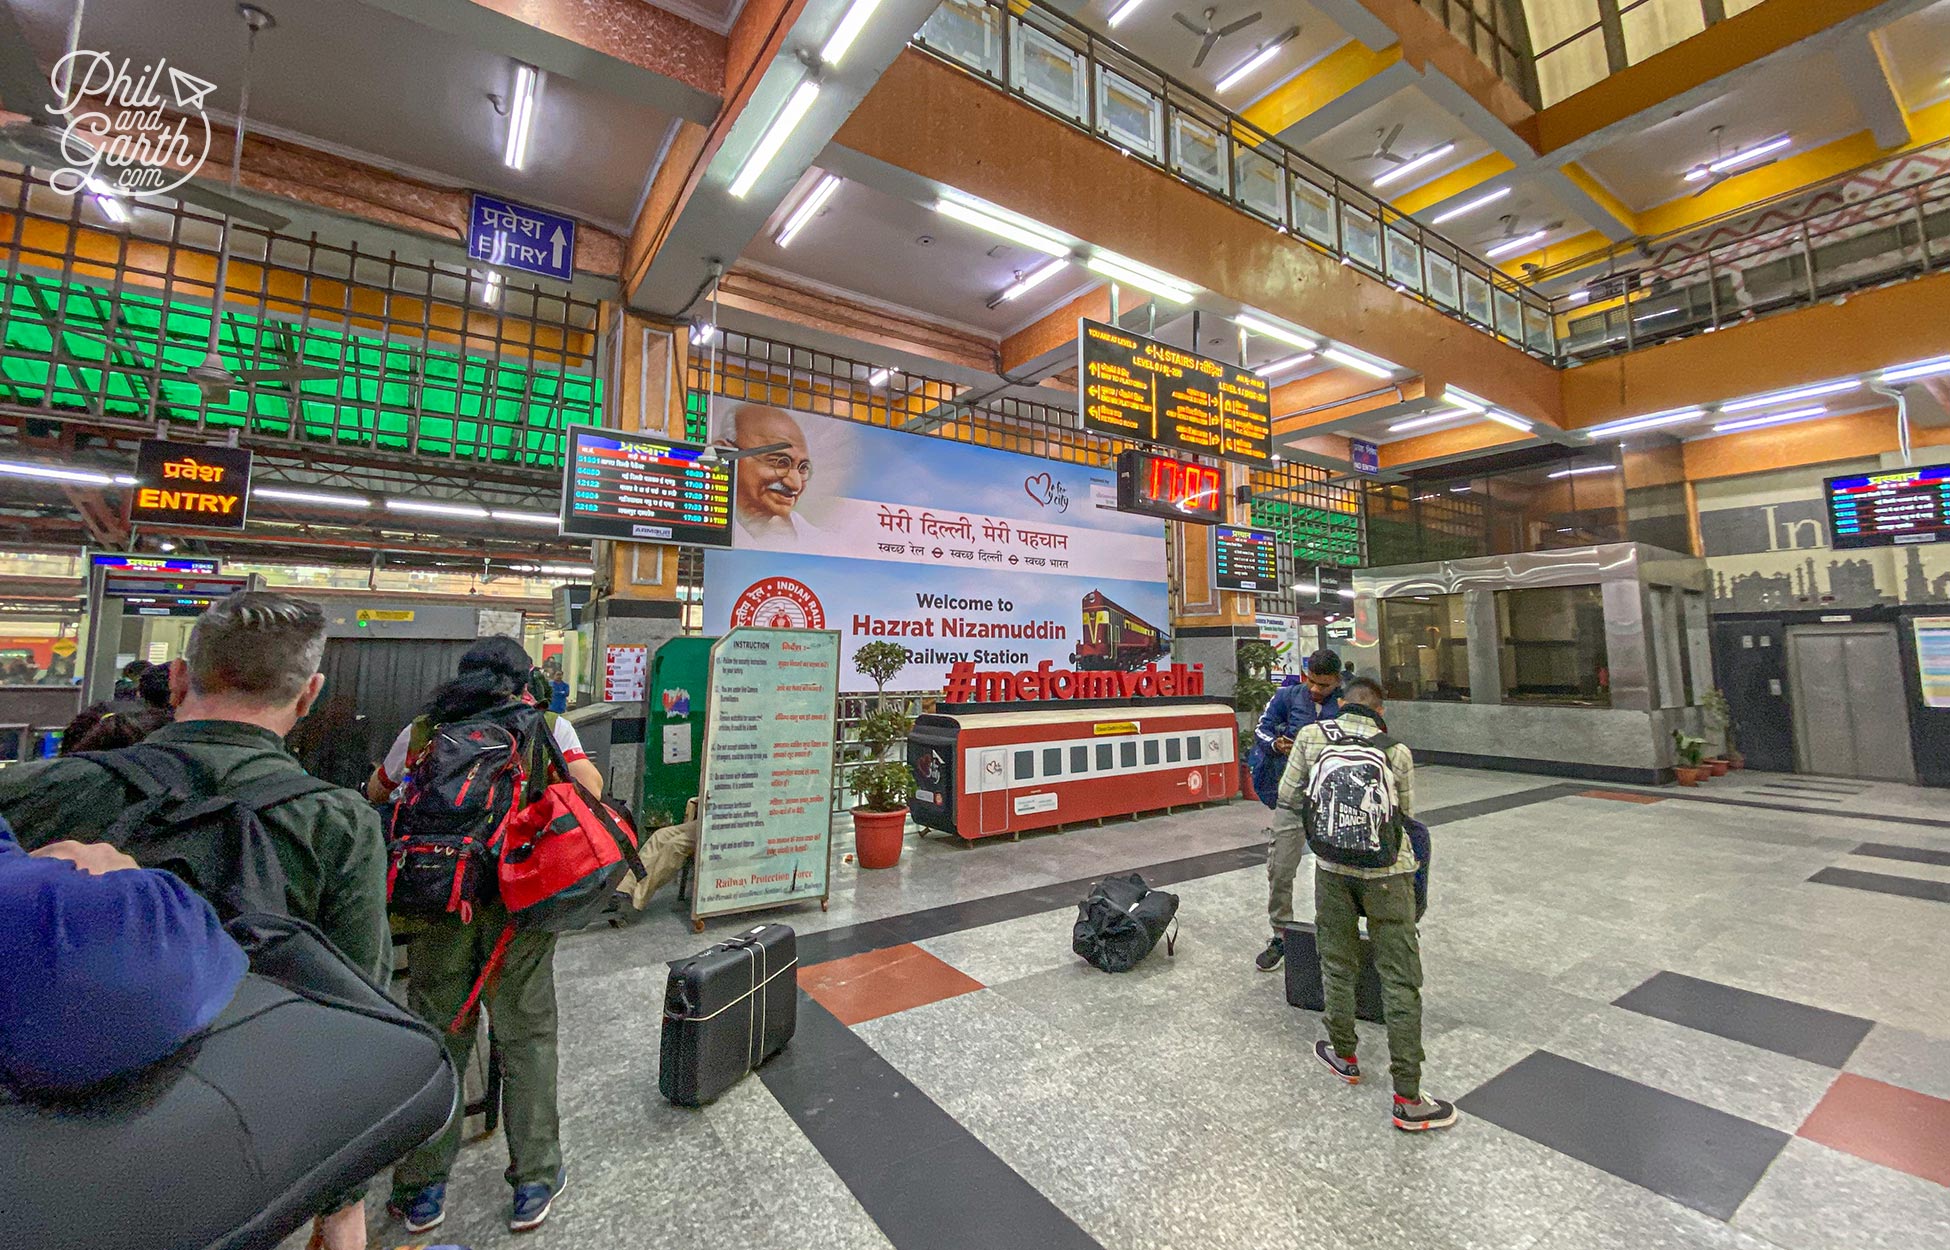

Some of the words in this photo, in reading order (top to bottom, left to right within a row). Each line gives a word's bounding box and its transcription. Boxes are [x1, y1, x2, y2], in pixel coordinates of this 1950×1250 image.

[481, 205, 545, 239] प्रवेश
[478, 234, 548, 265] ENTRY
[1132, 356, 1154, 370] LEVEL
[1164, 351, 1195, 369] STAIRS
[1218, 382, 1237, 394] LEVEL
[163, 458, 225, 482] प्रवेश
[1354, 462, 1362, 470] NO
[1362, 464, 1377, 472] ENTRY
[1150, 458, 1220, 511] 17:07
[139, 488, 238, 513] ENTRY
[877, 505, 913, 535] मेरी
[919, 513, 976, 544] दिल्ली,
[983, 517, 1011, 545] मेरी
[1016, 528, 1069, 550] पहचान
[878, 542, 905, 556] स्वच्छ
[908, 542, 925, 556] रेल
[950, 548, 974, 561] स्वच्छ
[978, 548, 1003, 563] दिल्ली
[1024, 555, 1046, 568] स्वच्छ
[1049, 558, 1069, 569] भारत
[777, 581, 811, 602] INDIAN
[916, 593, 993, 611] Welcome
[998, 598, 1014, 612] to
[852, 614, 934, 637] Hazrat
[942, 618, 1066, 640] Nizamuddin
[733, 641, 770, 650] INSTRUCTION
[904, 648, 969, 665] Railway
[973, 649, 1029, 664] Station
[1339, 802, 1358, 816] BORN
[1339, 813, 1367, 827] DANCE
[716, 878, 747, 888] Railway
[751, 872, 790, 884] Protection
